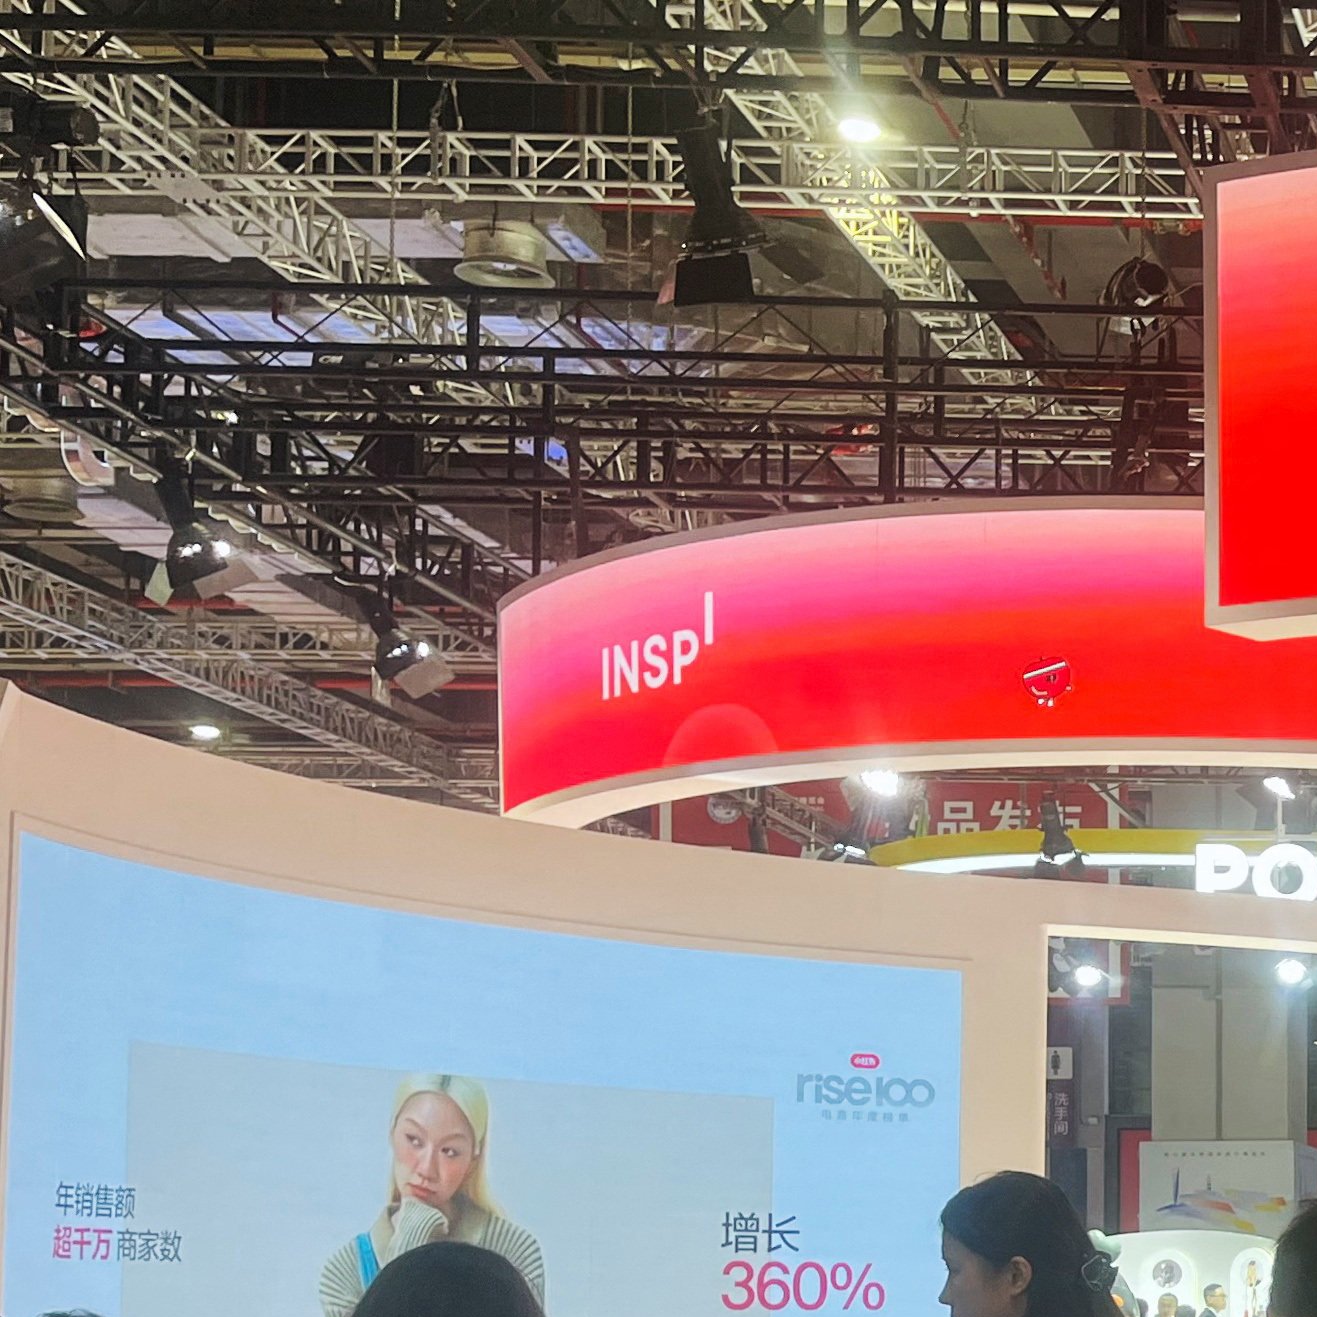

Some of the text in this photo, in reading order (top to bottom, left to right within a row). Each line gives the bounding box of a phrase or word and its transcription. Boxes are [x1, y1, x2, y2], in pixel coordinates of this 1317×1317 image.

[1053, 1092, 1069, 1135] 洗手间
[55, 1181, 136, 1219] 年销售额
[53, 1225, 183, 1262] 超千万 商家数
[721, 1212, 800, 1253] 增长
[721, 1260, 886, 1311] 360%
